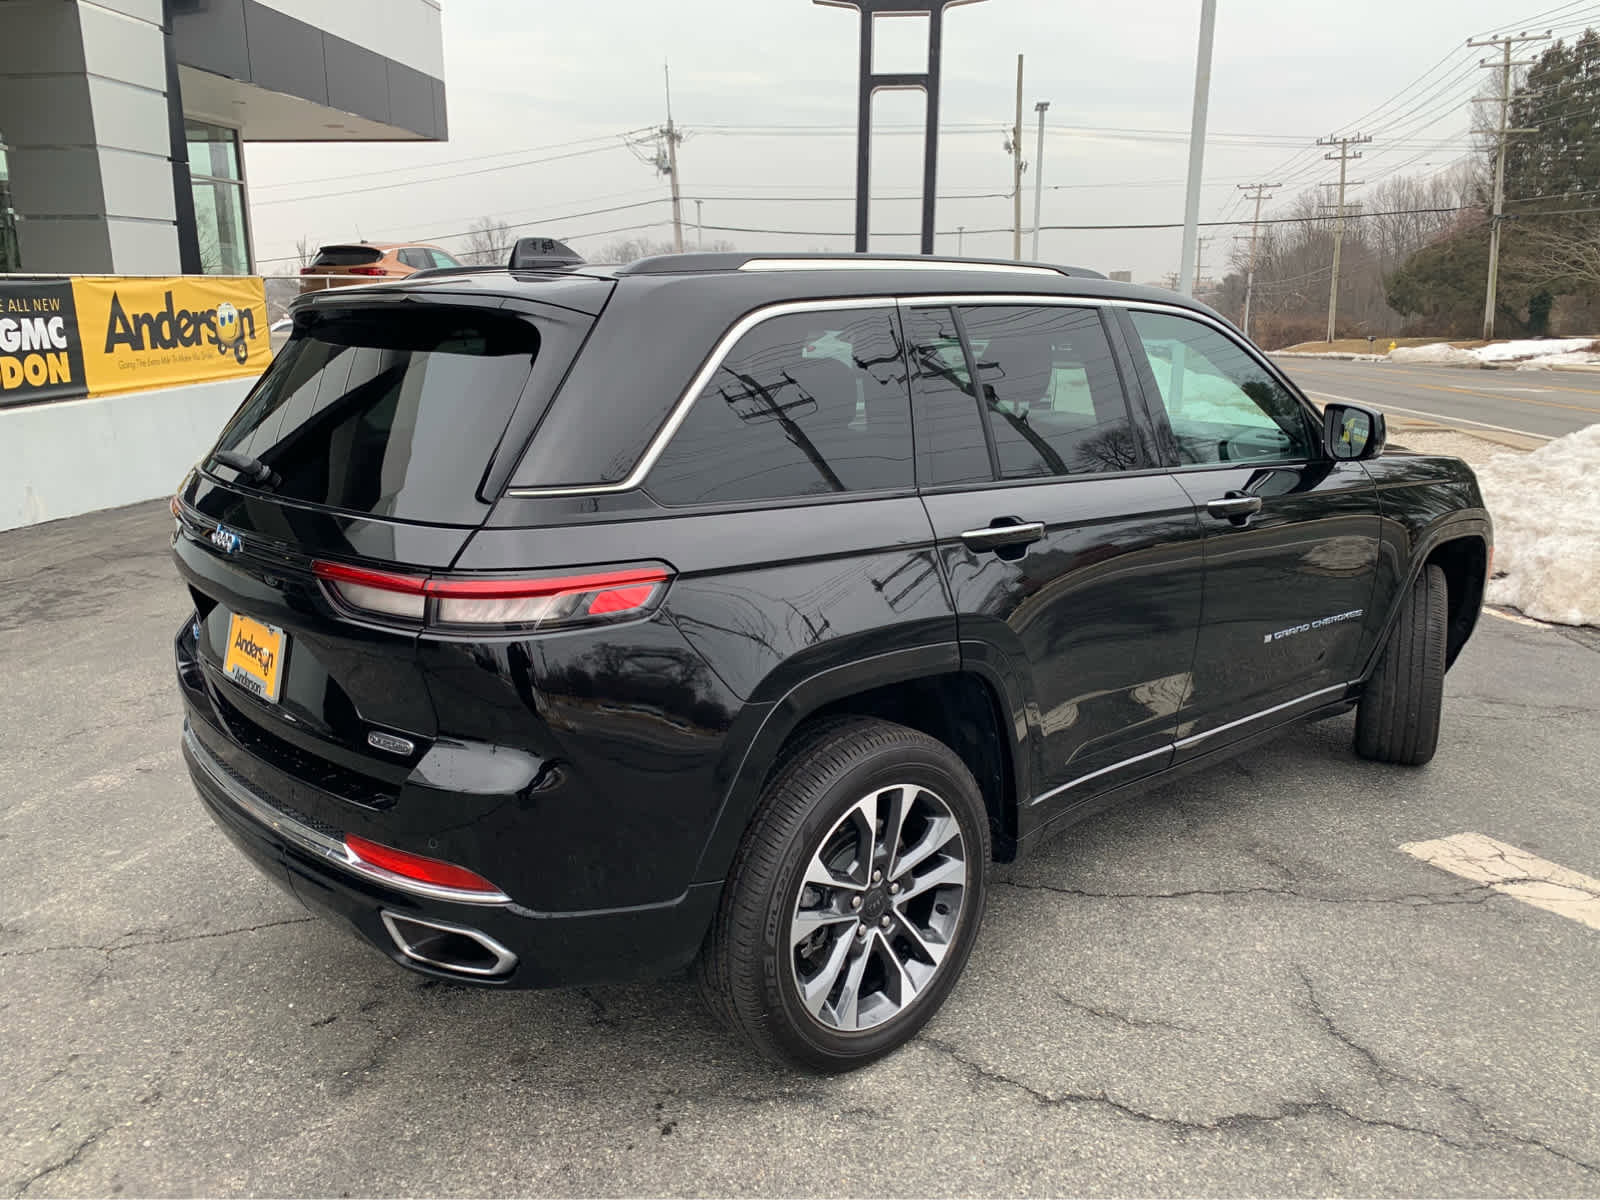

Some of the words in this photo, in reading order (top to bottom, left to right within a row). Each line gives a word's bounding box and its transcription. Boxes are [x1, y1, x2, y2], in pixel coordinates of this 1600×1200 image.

[8, 298, 31, 312] ALL
[33, 297, 60, 312] NEW
[0, 316, 68, 352] GMC
[104, 290, 256, 358] Anderson
[0, 351, 72, 390] DON
[1274, 623, 1310, 640] GRAND
[1311, 609, 1364, 628] CHEROKEE
[235, 628, 274, 669] Anderson
[234, 667, 262, 695] Anderson
